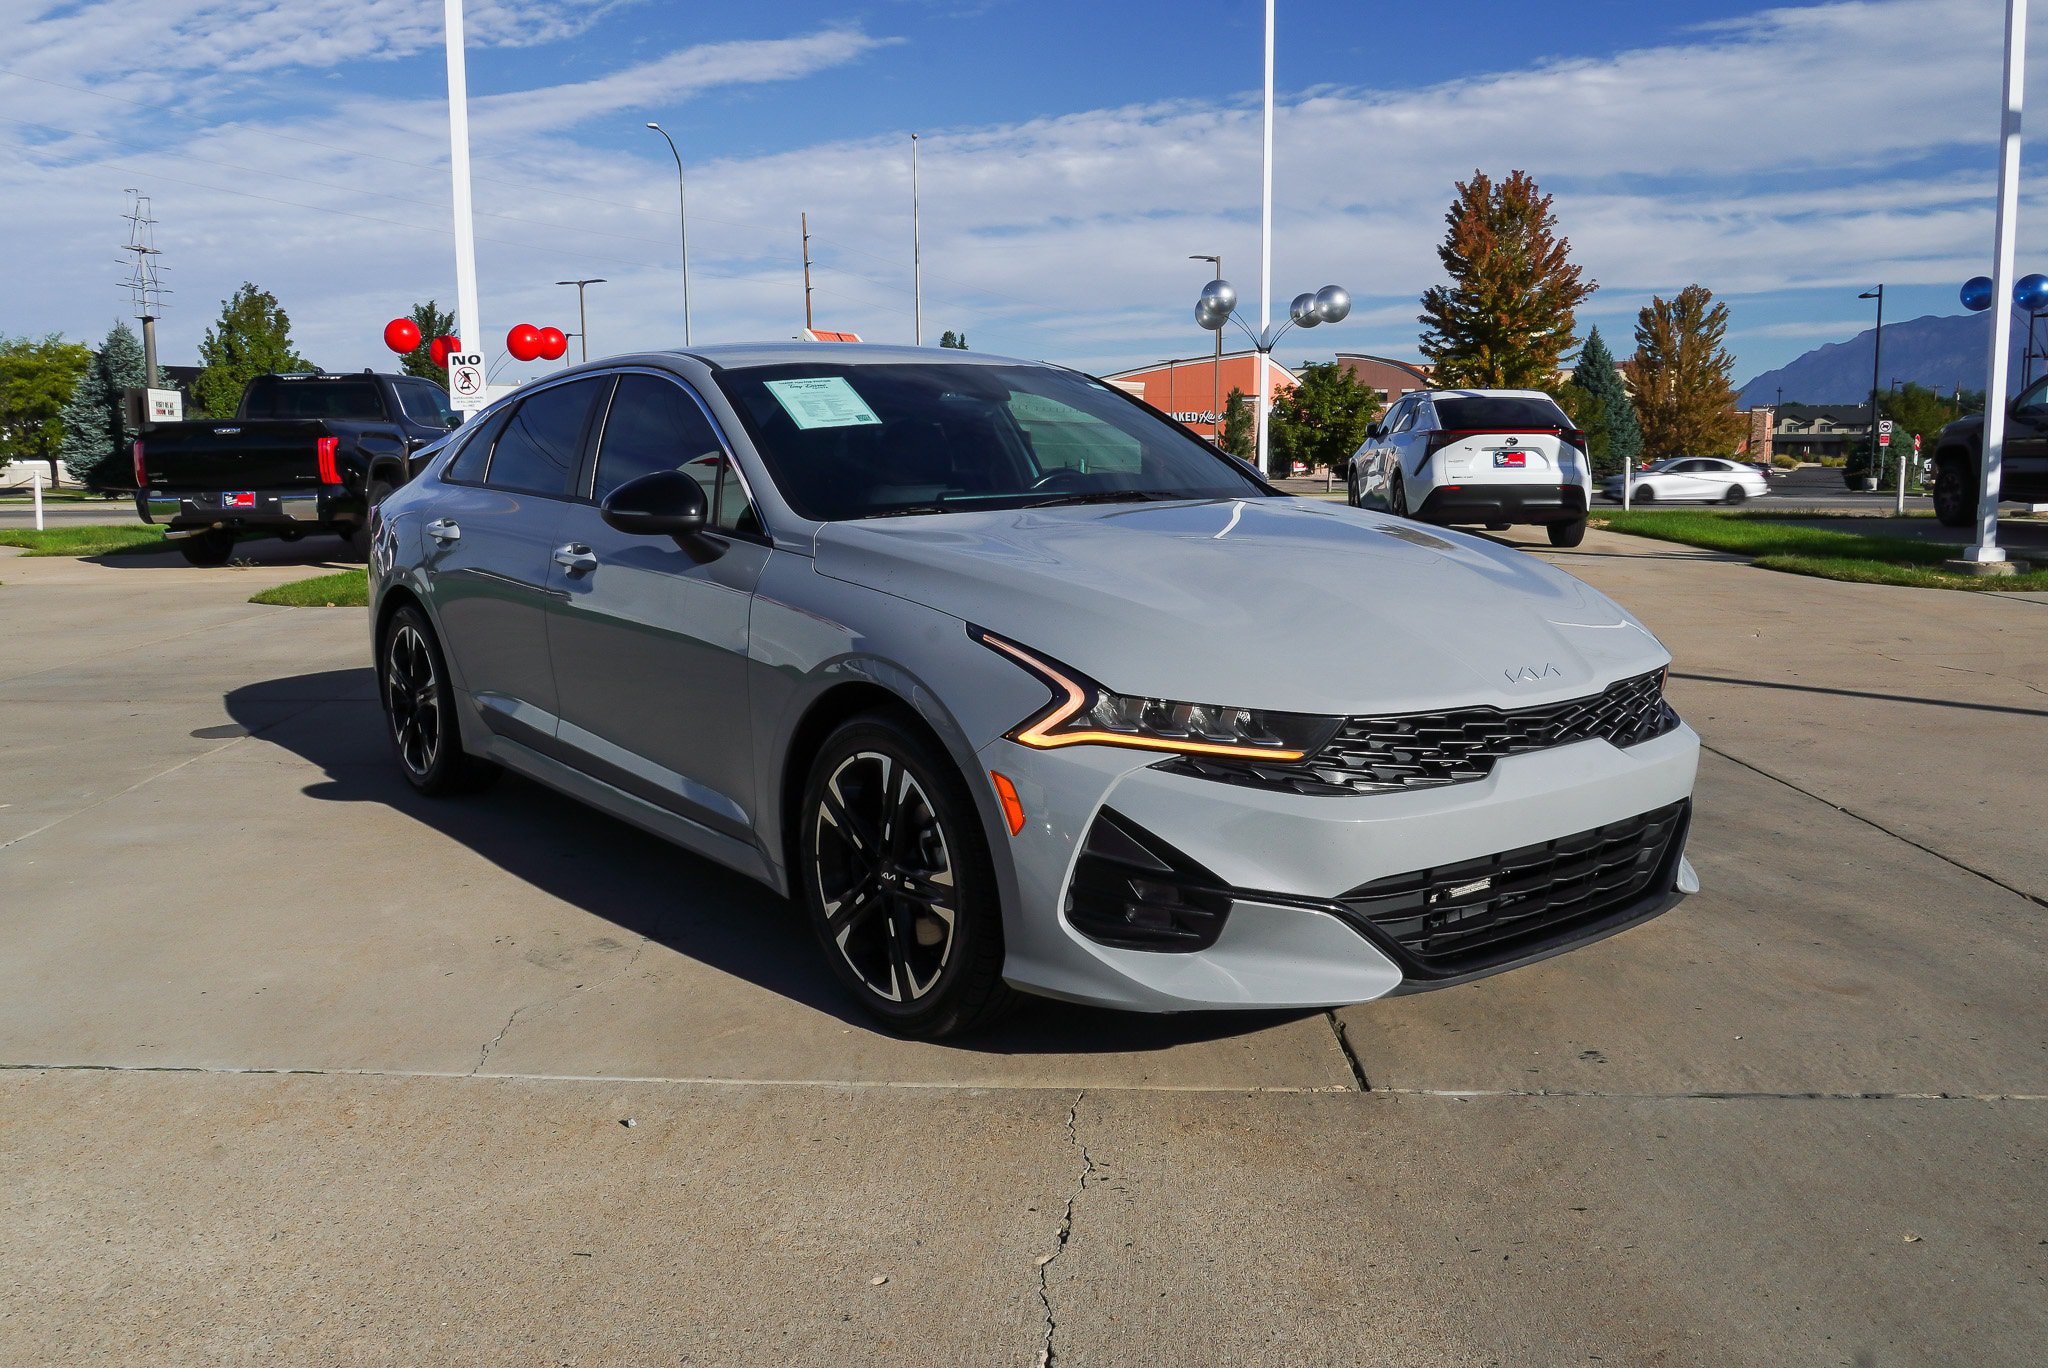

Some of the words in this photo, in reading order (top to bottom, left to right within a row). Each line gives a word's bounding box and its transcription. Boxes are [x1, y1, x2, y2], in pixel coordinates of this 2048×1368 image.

[452, 355, 481, 366] NO
[1165, 411, 1198, 422] AKED
[1504, 662, 1562, 684] KIA
